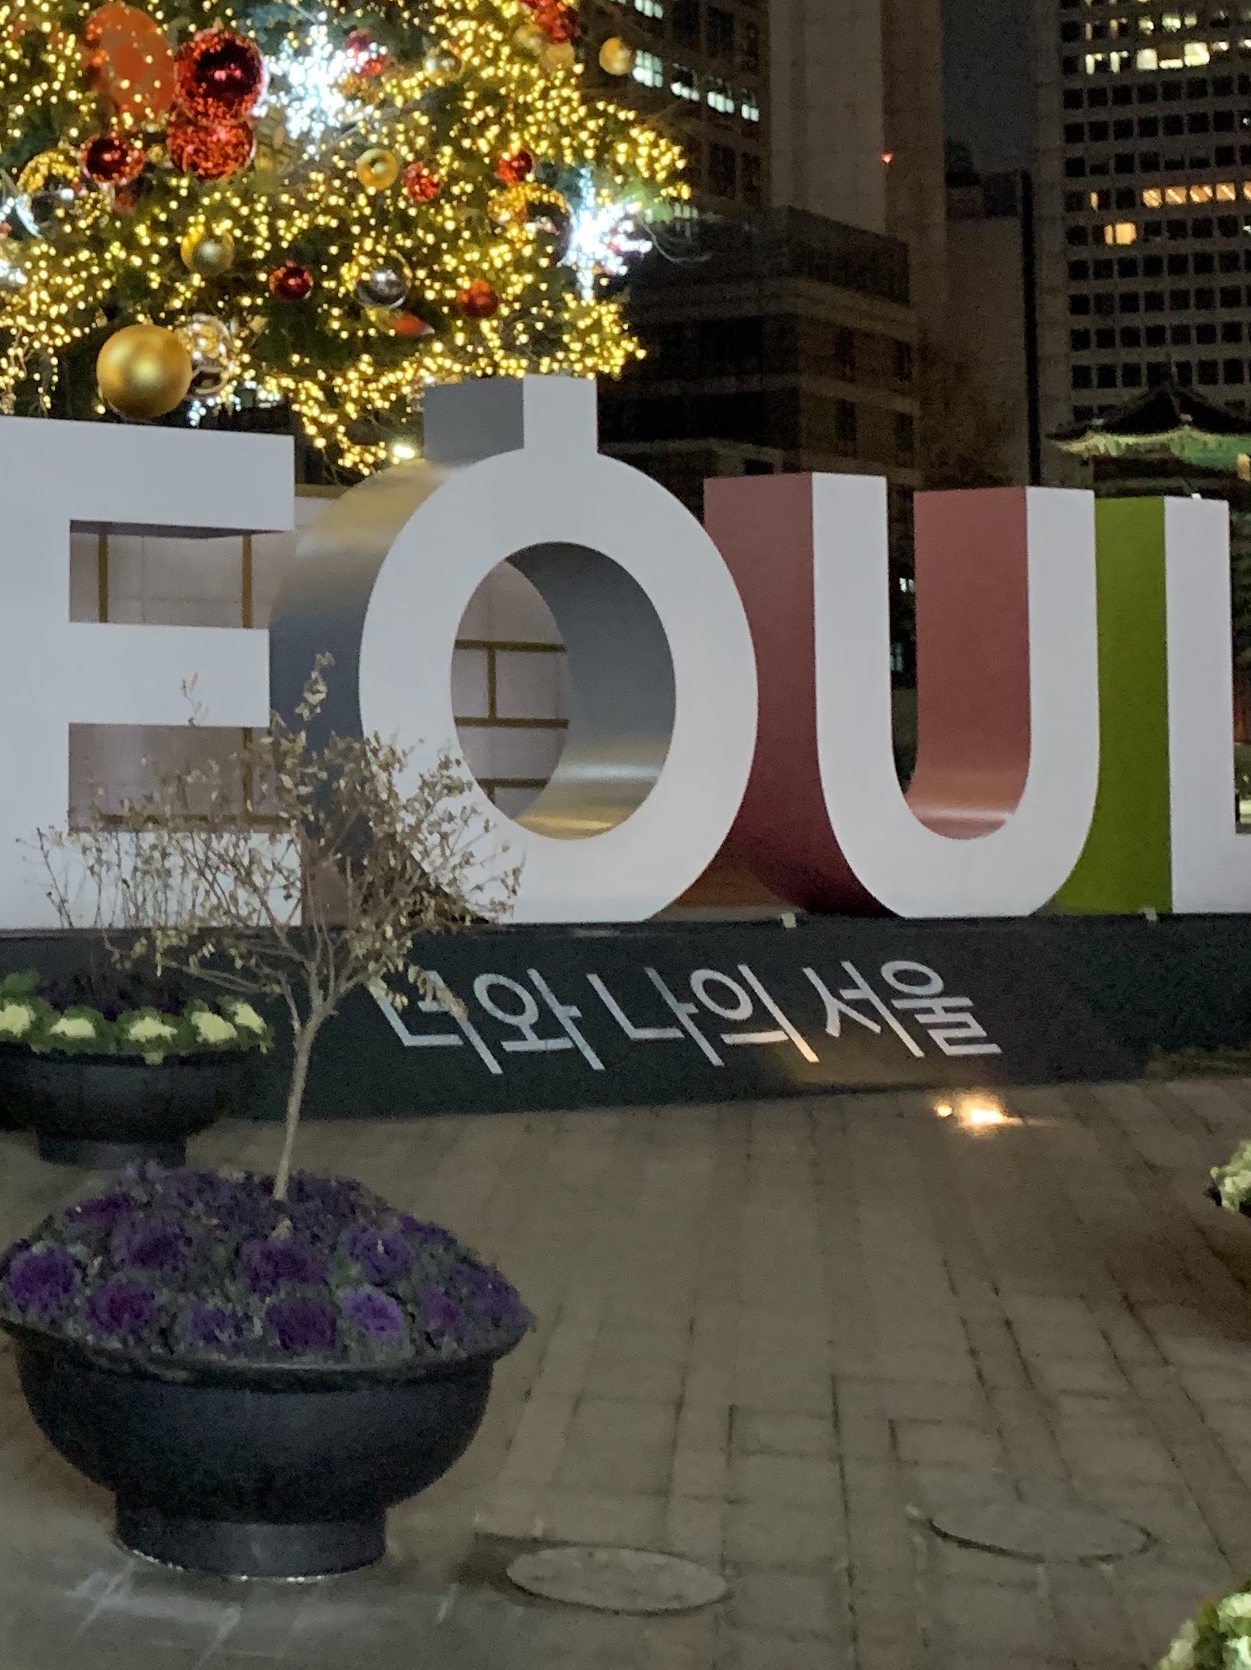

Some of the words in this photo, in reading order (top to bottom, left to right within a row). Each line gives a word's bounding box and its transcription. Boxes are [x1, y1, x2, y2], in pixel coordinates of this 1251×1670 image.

[360, 967, 605, 1074] 너와
[587, 963, 820, 1067] 나의
[802, 959, 1003, 1059] 서울
